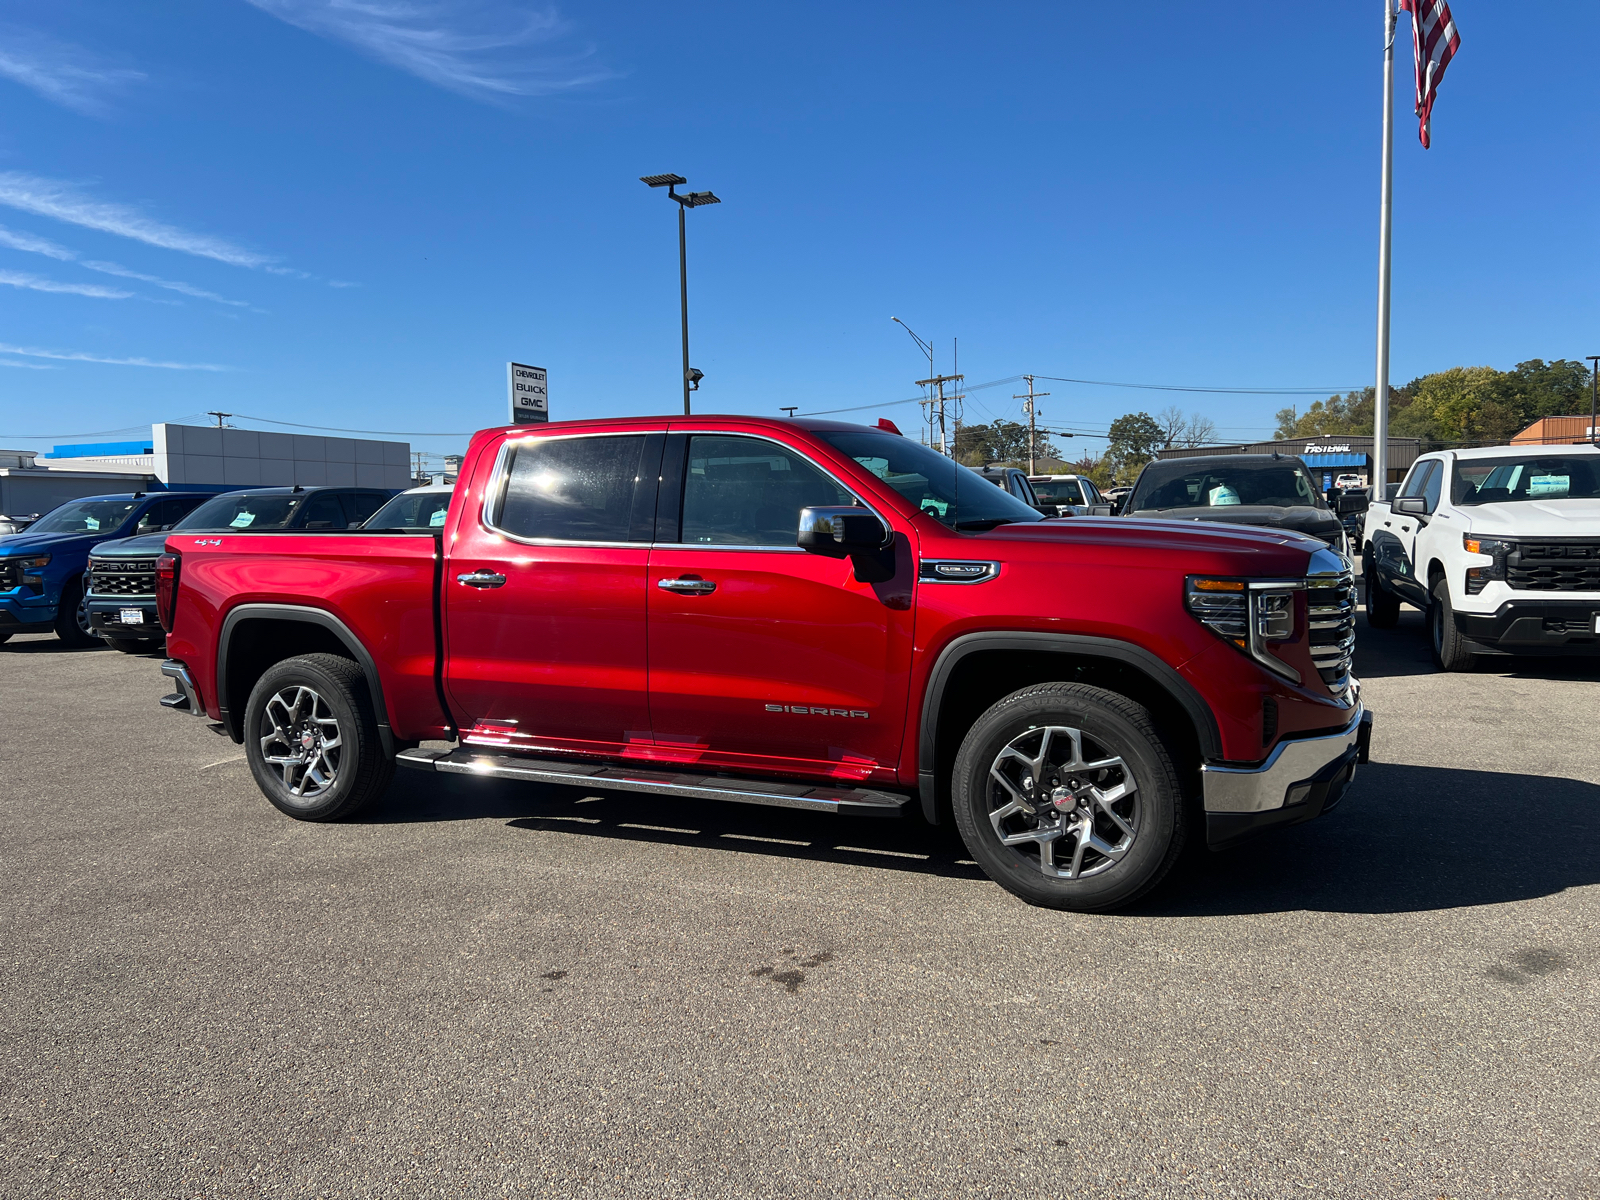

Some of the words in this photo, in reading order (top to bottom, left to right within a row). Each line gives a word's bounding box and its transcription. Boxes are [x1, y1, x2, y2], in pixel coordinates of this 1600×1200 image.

[515, 369, 545, 381] CHEVROLET
[516, 383, 545, 395] BUICK
[520, 397, 543, 408] GMC
[1304, 443, 1351, 453] FASTENAL
[765, 704, 869, 719] SIERRA
[1055, 794, 1074, 806] GMC
